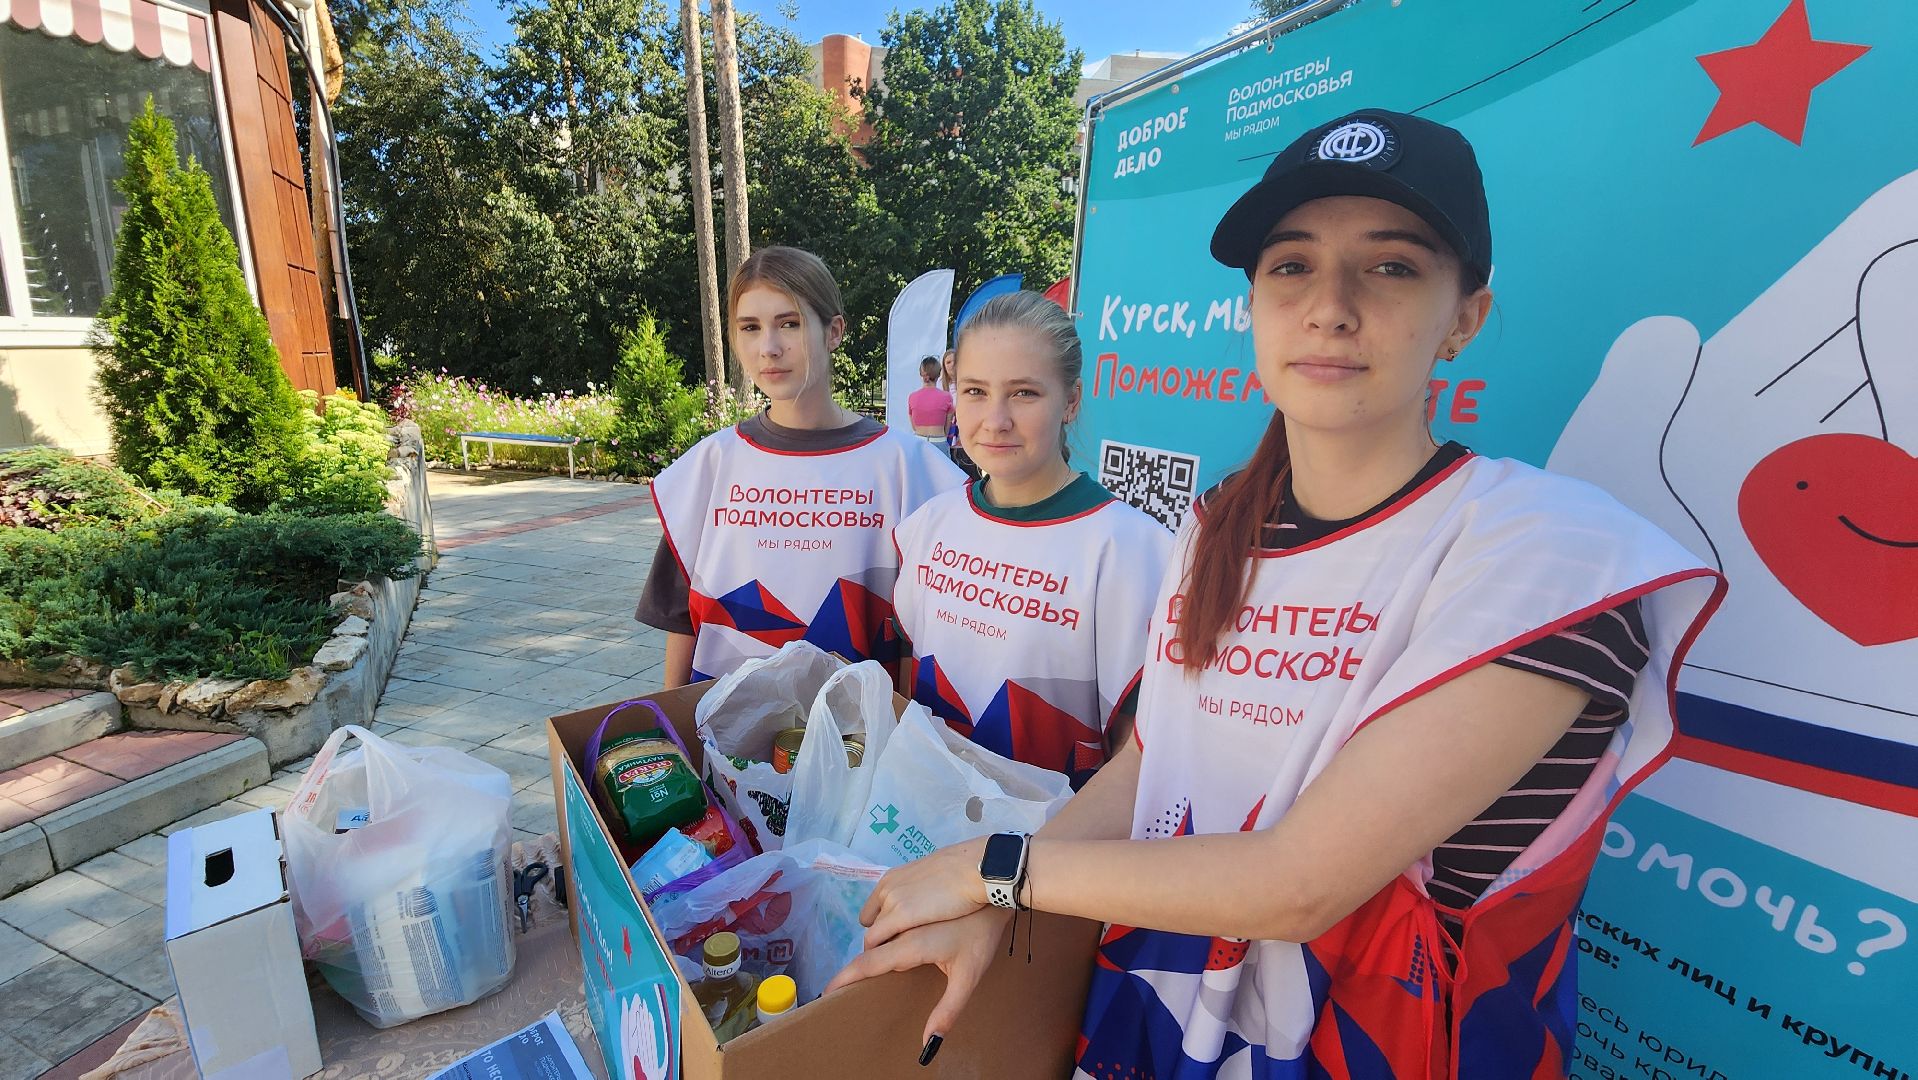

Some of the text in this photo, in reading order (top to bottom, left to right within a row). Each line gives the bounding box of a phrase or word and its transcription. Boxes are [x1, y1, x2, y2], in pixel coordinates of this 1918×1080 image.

[1226, 69, 1353, 124] ПОДМОСКОВЬЯ
[1228, 56, 1331, 106] ВОЛОНТЕРЫ
[1117, 106, 1189, 152] ДОБРОЕ
[1224, 116, 1280, 142] МЫ РЯДОМ
[1113, 147, 1162, 179] ДЕЛО
[1098, 294, 1196, 341] КУРСК,
[729, 484, 874, 505] ВОЛОНТЕРЫ
[714, 507, 885, 529] ПОДМОСКОВЬЯ
[757, 539, 832, 551] МЫ РЯДОМ
[931, 541, 1069, 596] ВОЛОНТЕРЫ
[936, 608, 1008, 641] МЫ РЯДОМ
[1198, 693, 1305, 728] МЫ РЯДОМ
[1600, 821, 1908, 977] ОМОЧЬ?
[704, 963, 734, 977] Altero
[1578, 937, 1620, 970] ов:
[1667, 957, 1737, 1006] лиц
[1747, 996, 1771, 1020] и
[1578, 991, 1629, 1034] есь
[1576, 1022, 1625, 1060] очь
